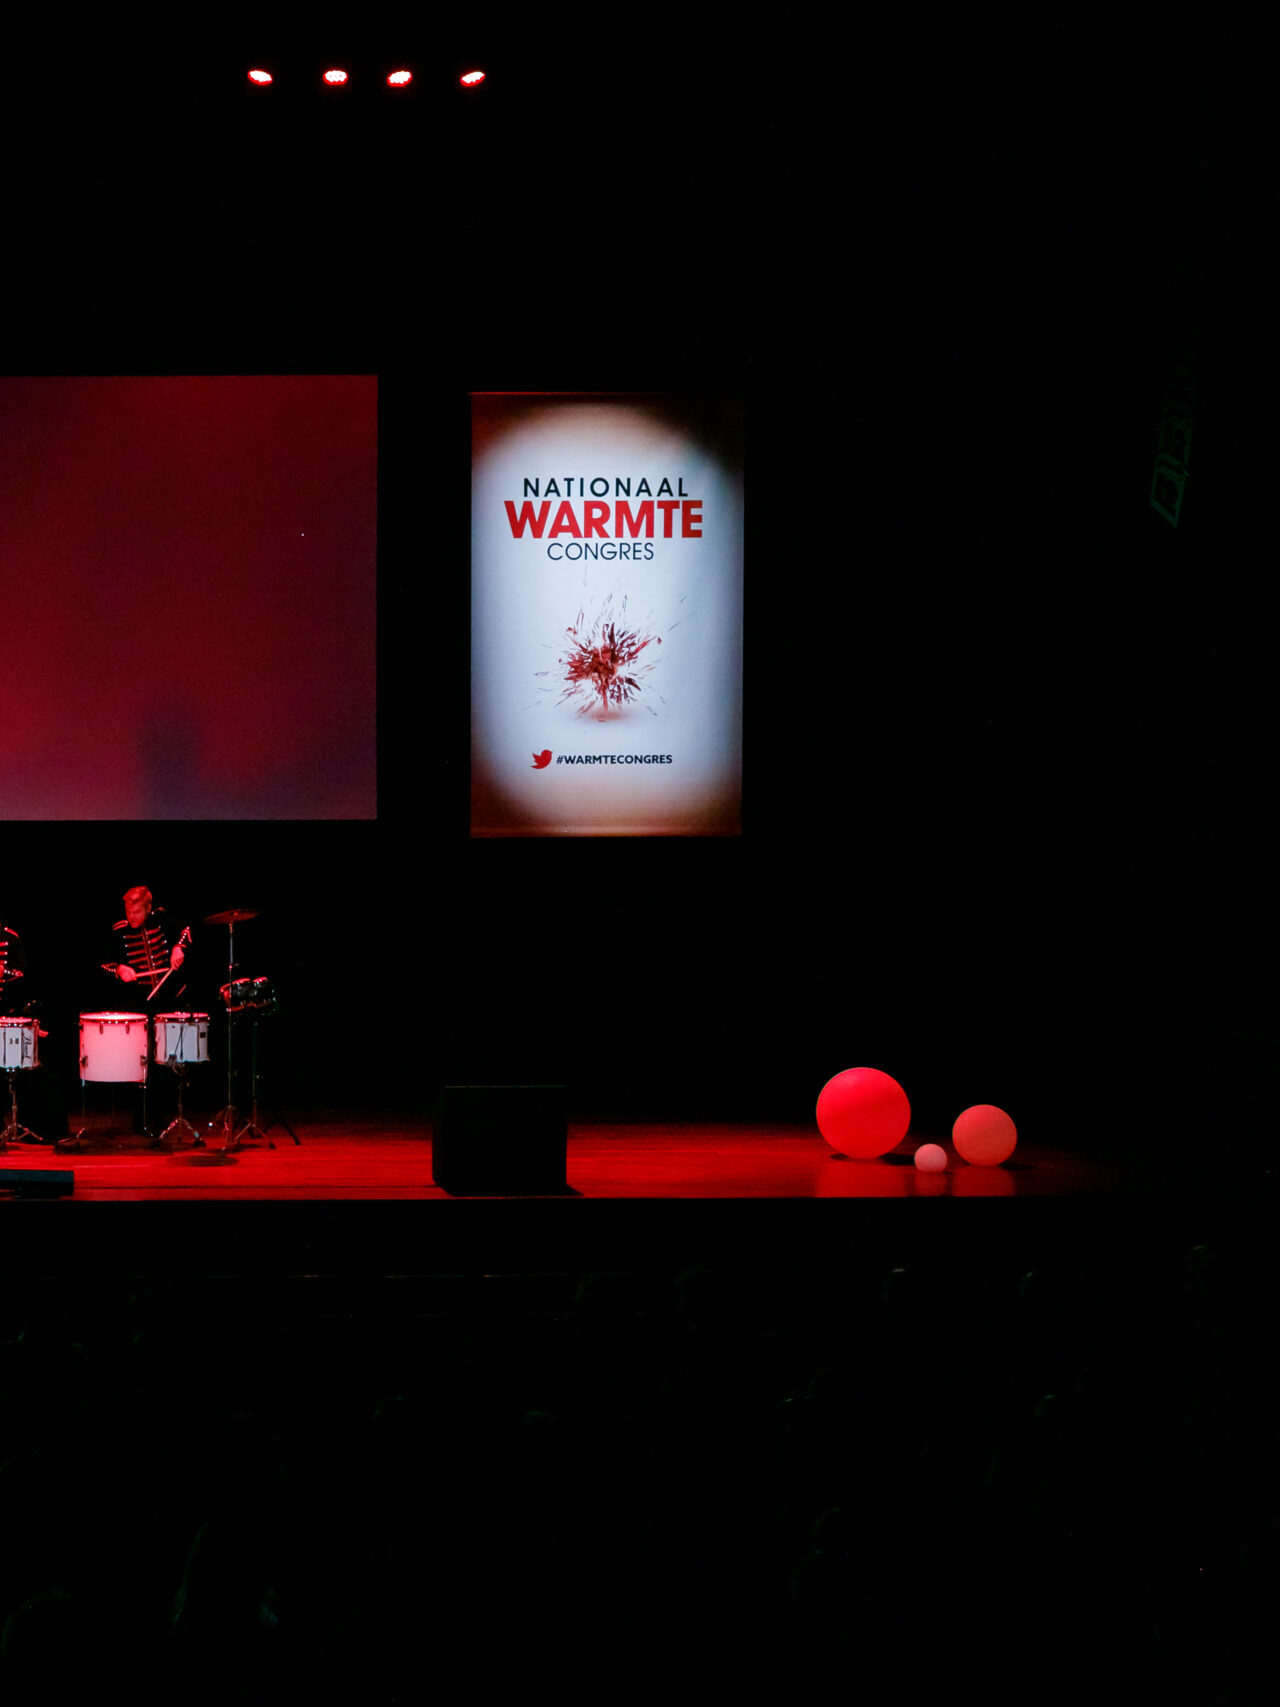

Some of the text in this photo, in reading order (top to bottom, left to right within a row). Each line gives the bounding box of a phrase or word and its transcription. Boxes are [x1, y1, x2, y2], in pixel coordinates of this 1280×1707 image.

[523, 477, 689, 498] NATIONAAL
[504, 500, 704, 539] WARMTE
[546, 542, 654, 561] CONGRES
[556, 754, 673, 765] #WARMTECONGRES
